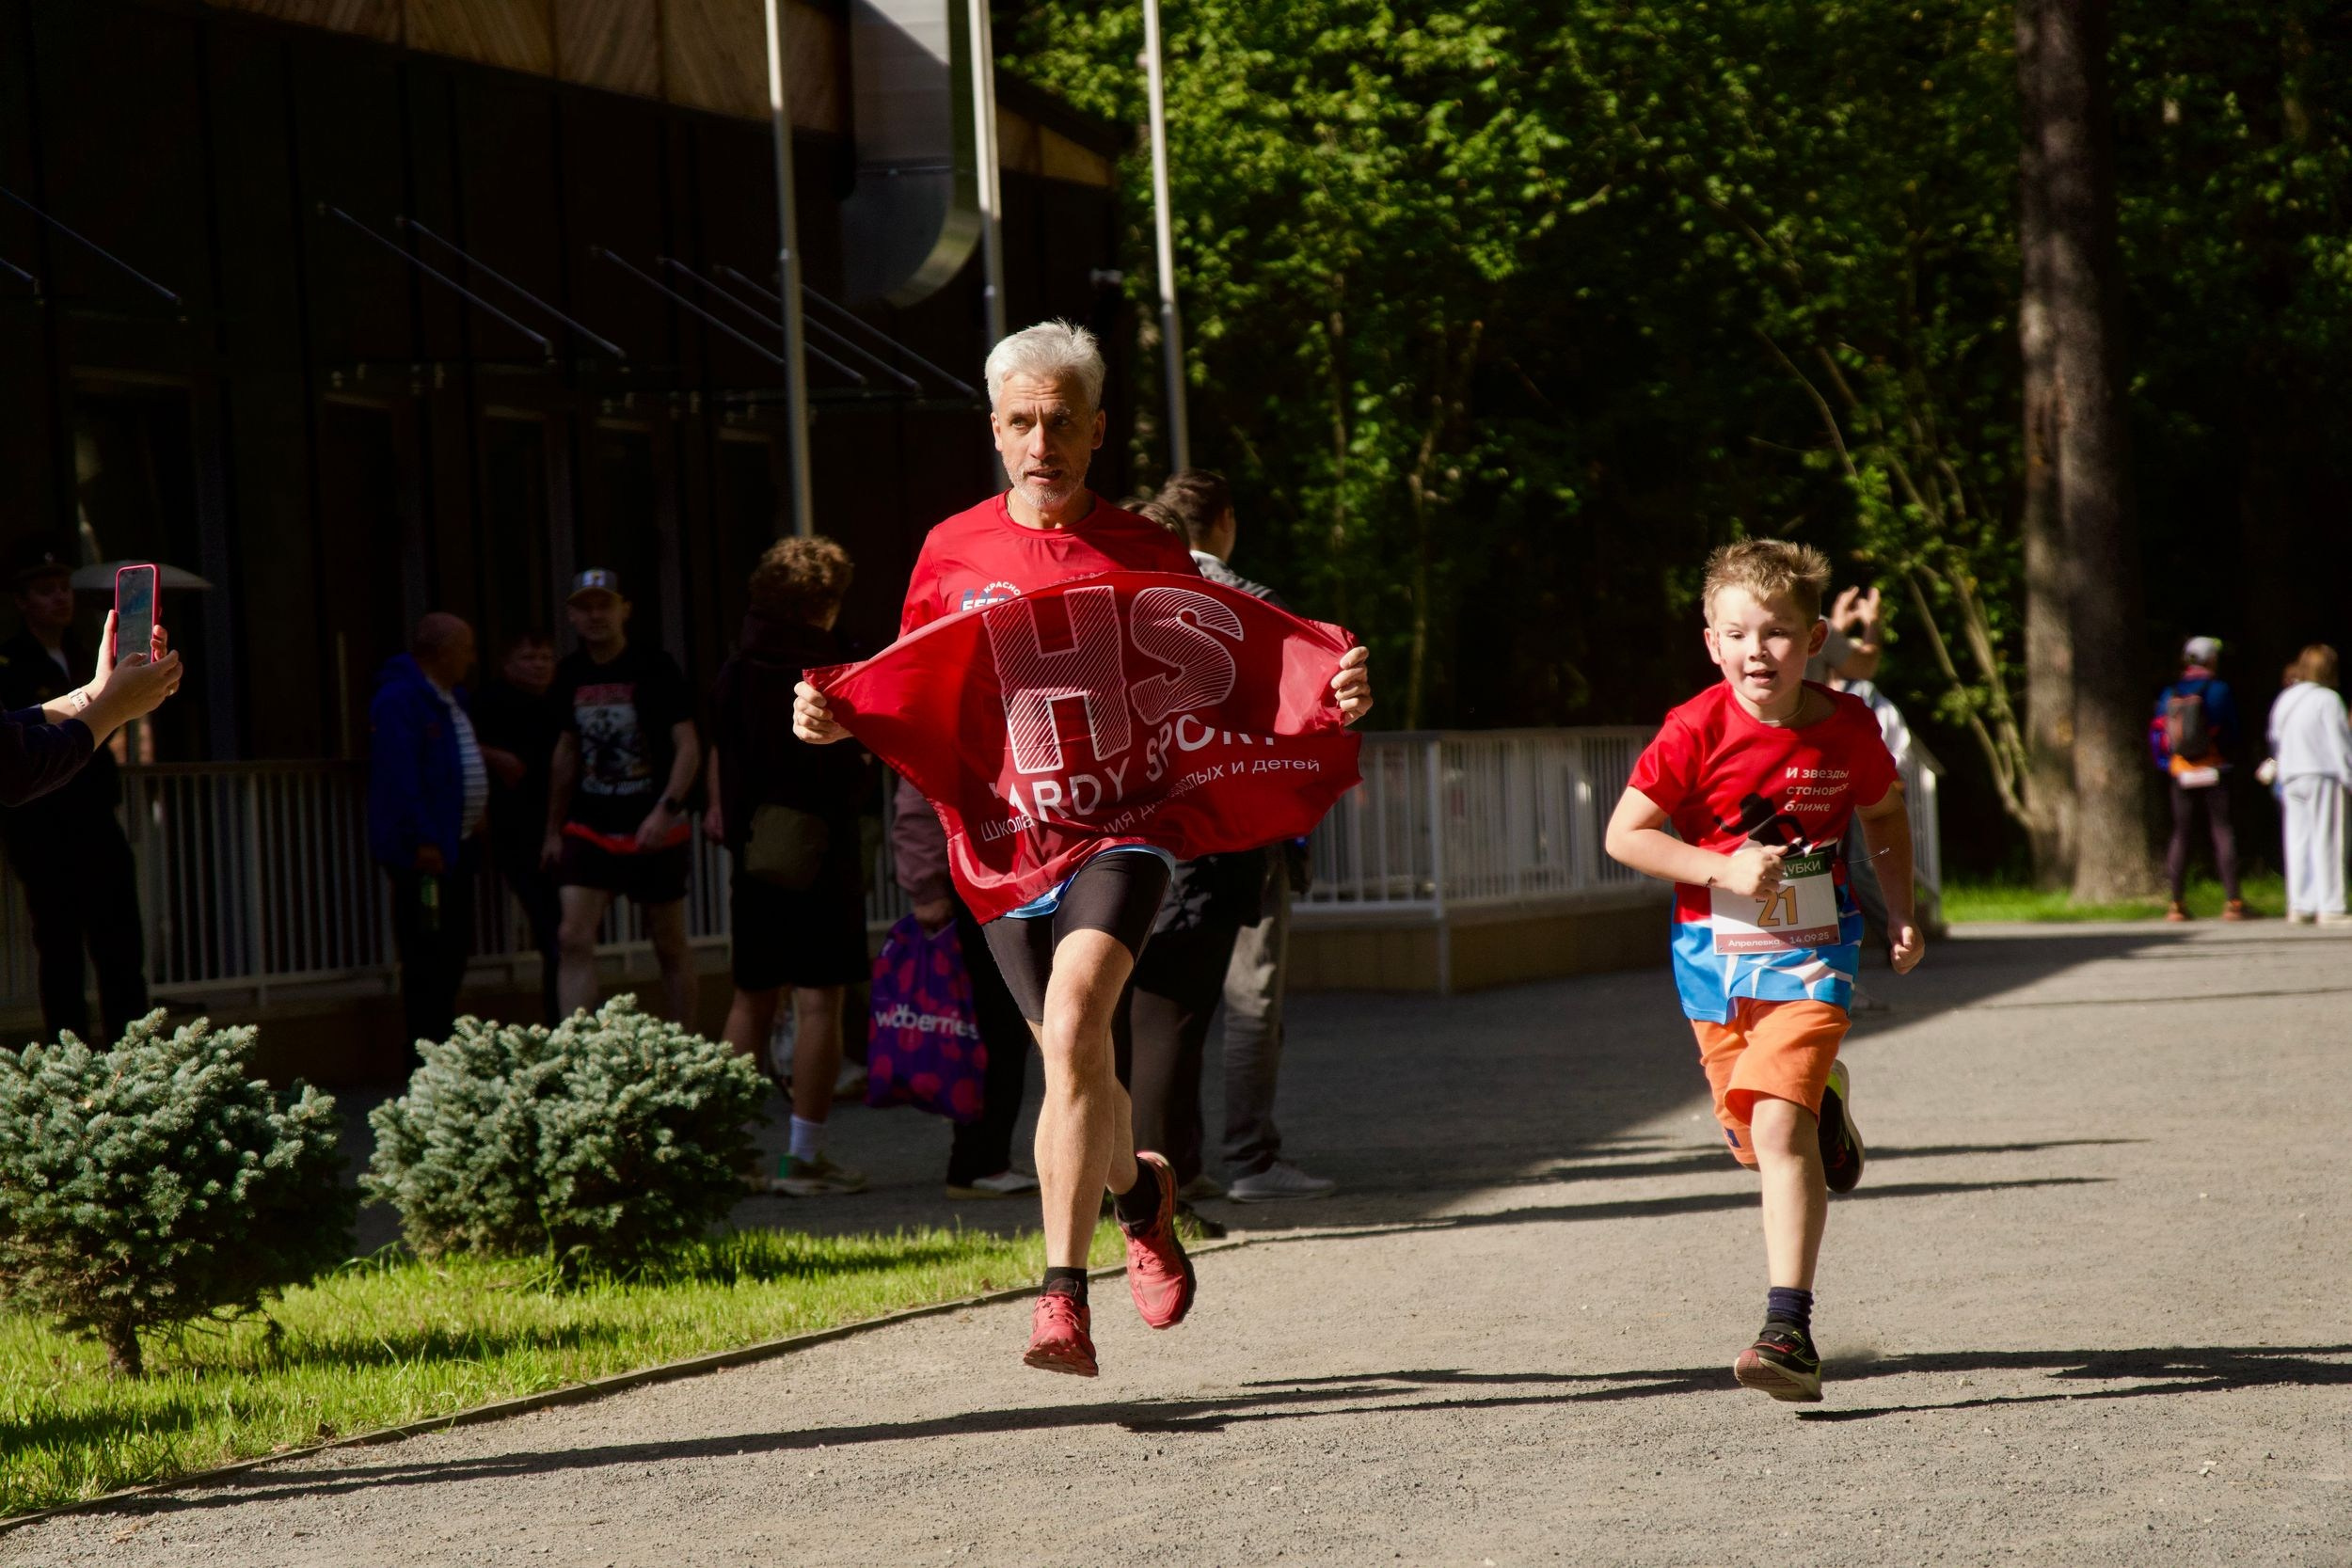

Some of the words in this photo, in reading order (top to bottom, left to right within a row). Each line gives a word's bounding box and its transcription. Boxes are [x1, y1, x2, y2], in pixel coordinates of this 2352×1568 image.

[981, 584, 1244, 775] HS
[1786, 767, 1799, 779] И
[1801, 768, 1850, 781] звезды
[980, 814, 1035, 843] Школа
[1231, 760, 1245, 775] и
[1251, 758, 1321, 775] детей
[1784, 800, 1831, 813] ближе
[1755, 885, 1799, 927] 21
[1727, 939, 1780, 949] Апрелевка
[1788, 931, 1830, 944] 14.09.25
